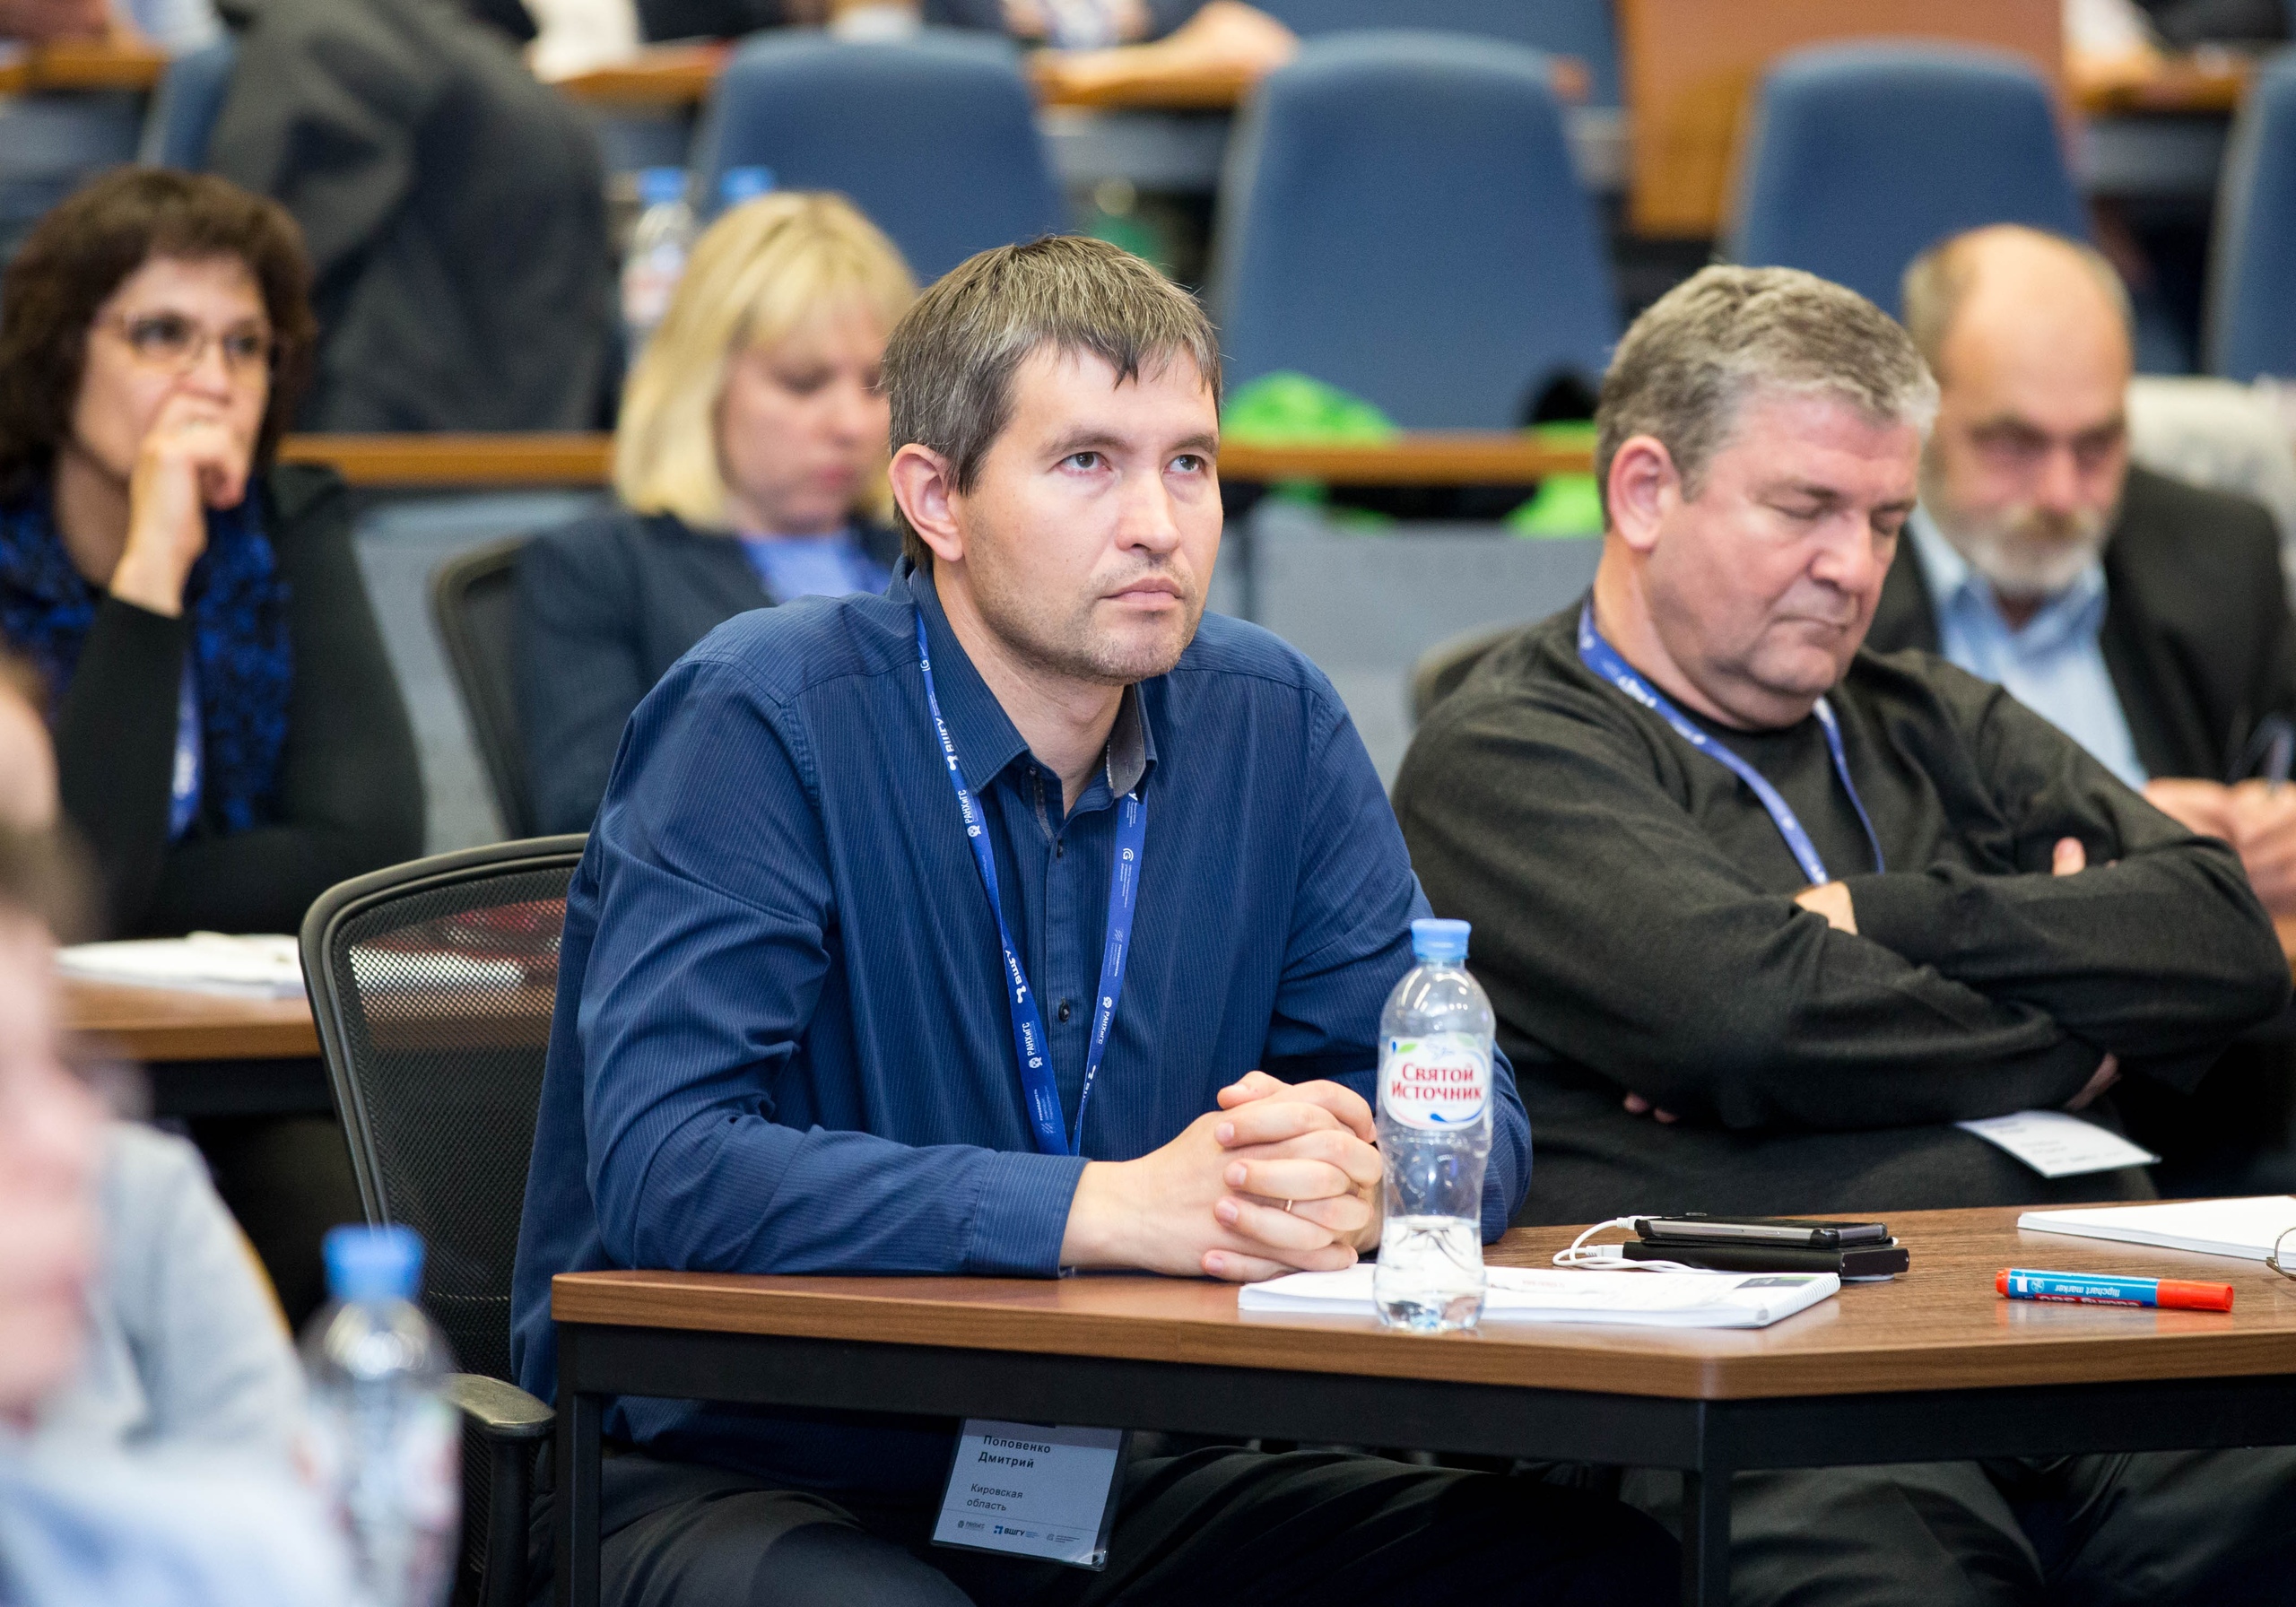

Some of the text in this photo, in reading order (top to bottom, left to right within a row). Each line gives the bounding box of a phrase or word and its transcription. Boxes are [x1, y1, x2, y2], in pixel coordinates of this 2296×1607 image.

[958, 789, 973, 824] РАНХиГС
[1098, 1011, 1110, 1045] РАНХиГС
[1022, 1021, 1035, 1056] РАНХиГС
[2055, 1284, 2121, 1298] flipchart marker
[983, 1435, 1051, 1454] Поповенко
[978, 1452, 1034, 1469] Дмитрий
[970, 1483, 1023, 1498] Кировская
[966, 1498, 1007, 1511] область
[1004, 1527, 1025, 1536] ВШГУ
